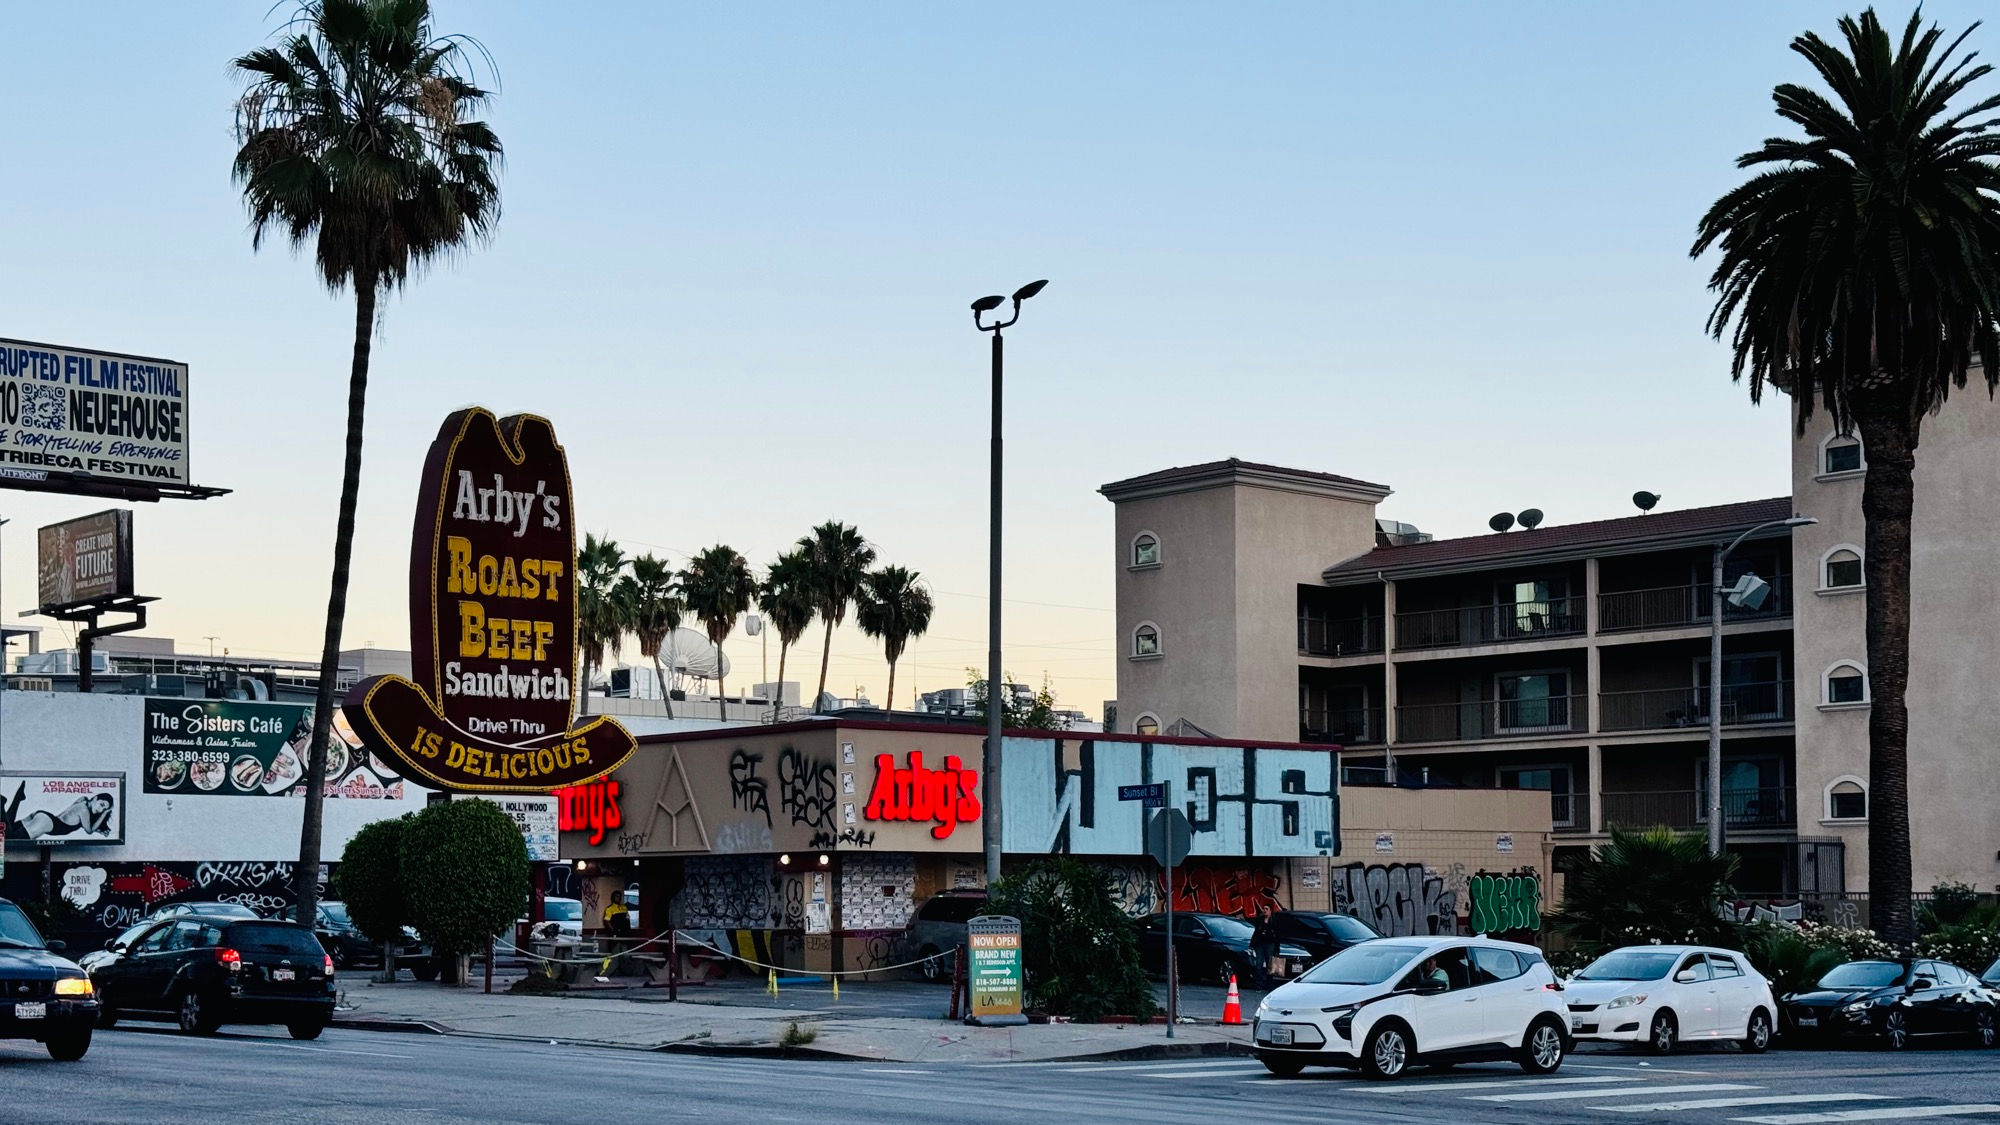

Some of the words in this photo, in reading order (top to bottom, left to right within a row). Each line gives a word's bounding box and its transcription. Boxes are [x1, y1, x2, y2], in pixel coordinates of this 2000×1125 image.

[0, 346, 60, 382] RUPTED
[64, 355, 119, 390] FILM
[122, 362, 182, 398] FESTIVAL
[0, 381, 19, 425] 10
[69, 388, 182, 443] NEUEHOUSE
[13, 430, 102, 454] STORYTELLING
[108, 440, 181, 461] EXPERIENCE
[0, 449, 84, 470] TRIBECA
[87, 458, 181, 480] FESTIVAL
[0, 468, 44, 479] UTFRONT
[452, 470, 561, 537] Arby's
[75, 536, 97, 554] CREATE
[97, 532, 113, 547] YOUR
[75, 548, 114, 580] FUTURE
[447, 536, 563, 601] ROAST
[458, 600, 554, 661] BEEF
[445, 662, 570, 700] Sandwich
[151, 712, 179, 730] The
[182, 705, 246, 734] Sisters
[250, 717, 283, 733] Café
[468, 717, 508, 733] Drive
[510, 718, 546, 735] Thru
[151, 735, 195, 746] Vietnamese
[196, 737, 203, 746] &
[205, 737, 229, 747] Asian
[230, 737, 258, 748] Fusion
[411, 726, 443, 759] IS
[445, 737, 591, 780] DELICIOUS
[151, 749, 231, 763] 323-380-6599
[42, 786, 93, 794] APPAREL
[66, 781, 117, 789] ANGELES
[862, 750, 981, 840] Arby's
[1123, 788, 1148, 798] Sunset
[1150, 786, 1158, 796] Bl
[506, 802, 548, 812] HOLLYWOOD
[552, 775, 622, 846] rby's
[69, 886, 87, 896] THRU
[71, 875, 91, 885] DRIVE
[974, 937, 993, 946] NOW
[996, 937, 1017, 946] OPEN
[976, 951, 999, 959] BRAND
[1001, 950, 1016, 959] NEW
